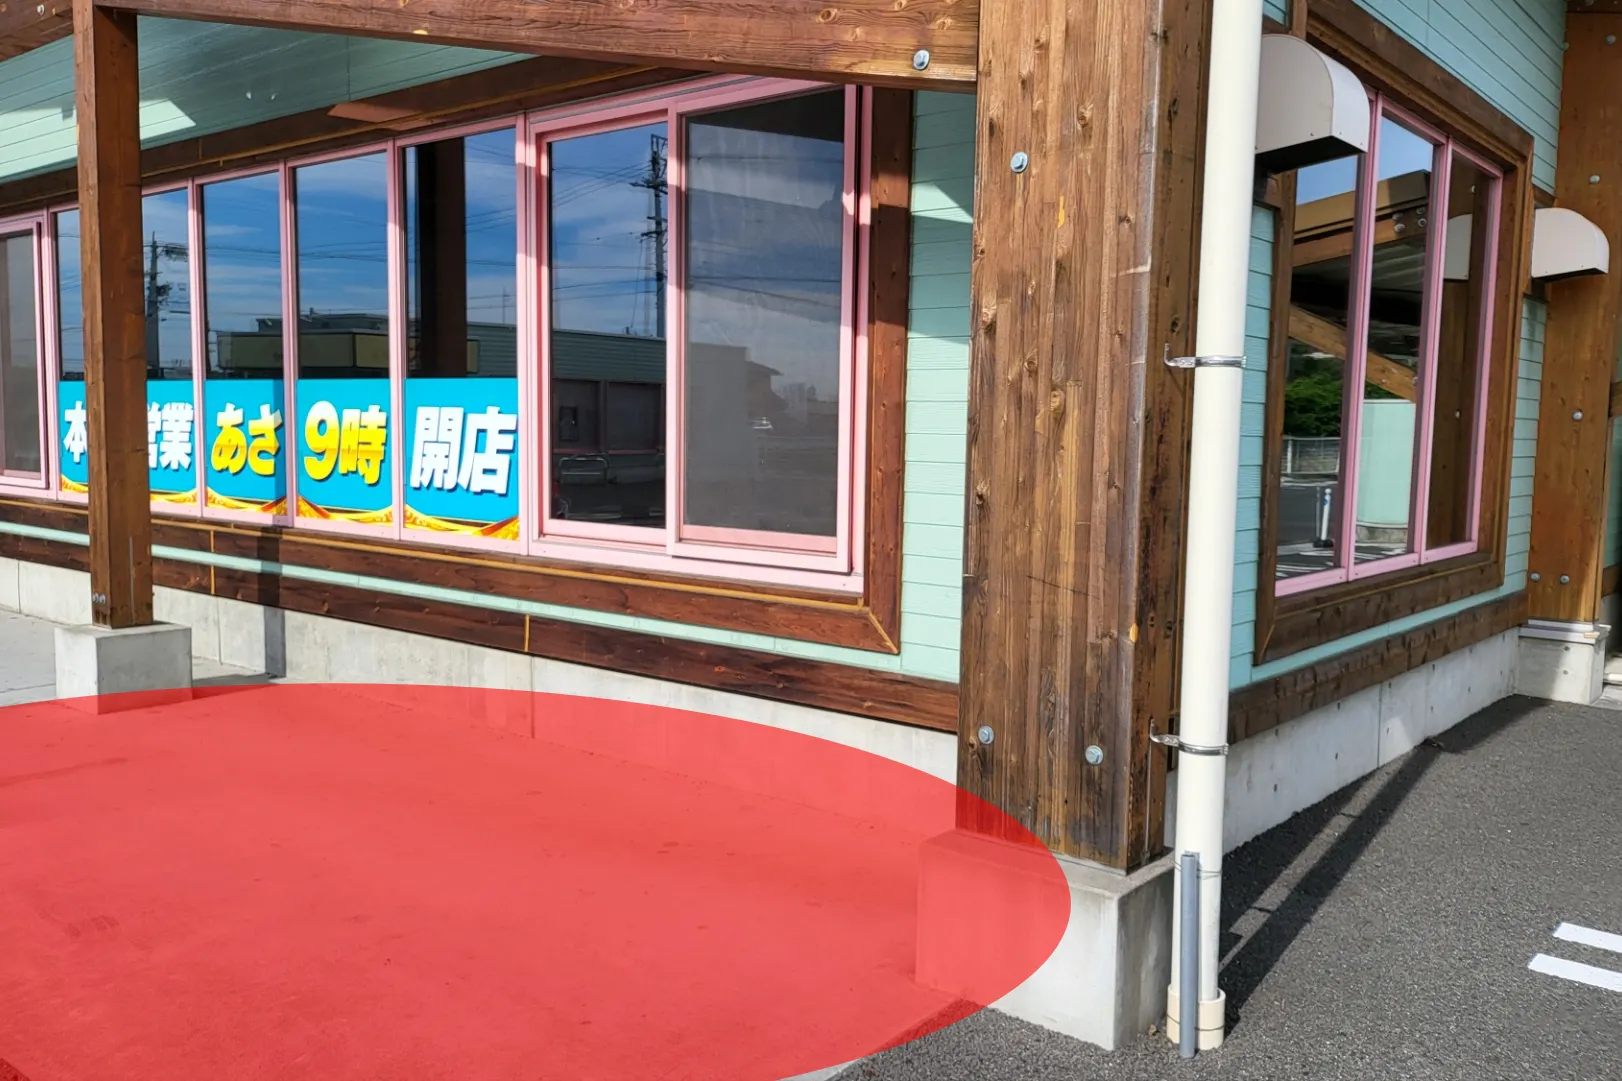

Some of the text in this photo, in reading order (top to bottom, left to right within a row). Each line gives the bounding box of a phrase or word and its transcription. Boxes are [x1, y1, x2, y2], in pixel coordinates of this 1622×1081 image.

[63, 400, 517, 495] 本業 あさ 9時 開店
